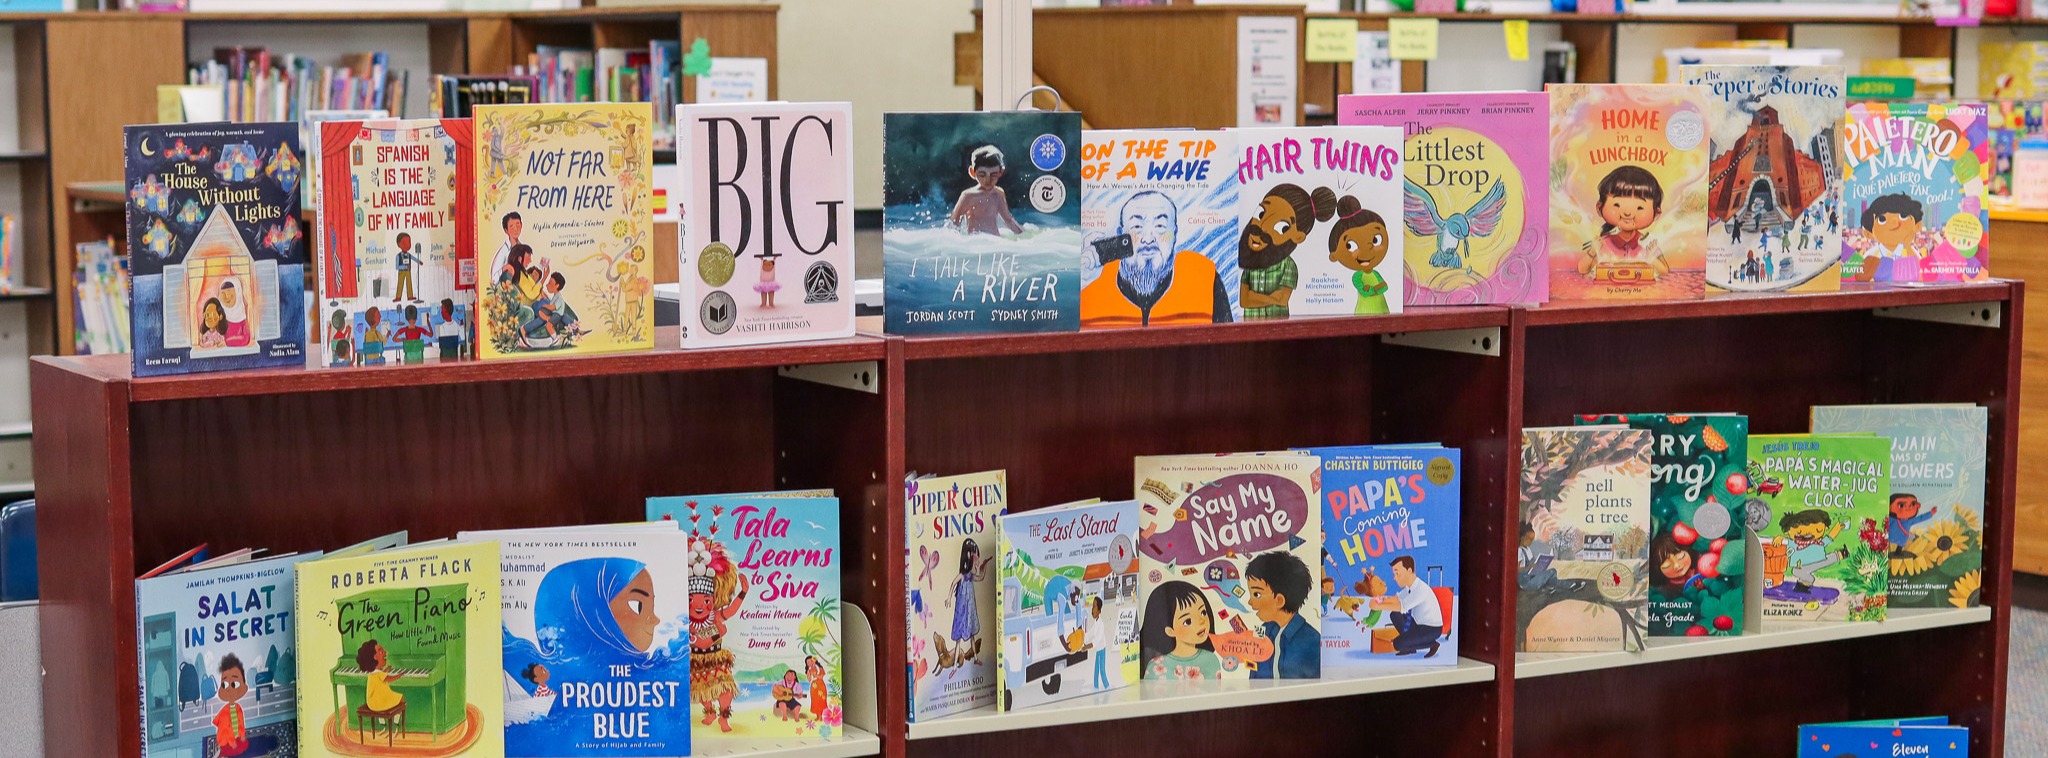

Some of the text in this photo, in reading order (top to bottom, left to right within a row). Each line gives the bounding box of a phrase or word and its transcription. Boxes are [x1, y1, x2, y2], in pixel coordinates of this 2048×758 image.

[1704, 70, 1721, 80] The
[1757, 82, 1768, 91] of
[1769, 74, 1839, 99] Stories
[1384, 108, 1406, 116] ALPER
[1439, 107, 1471, 115] PINKNEY
[1504, 106, 1535, 114] PINKNEY
[1968, 108, 1987, 117] DIAZ
[1404, 121, 1433, 135] The
[1601, 109, 1660, 131] HOME
[1616, 131, 1643, 143] in a
[1844, 115, 1958, 168] PALETERO
[377, 145, 430, 163] SPANISH
[1081, 139, 1217, 161] ON THE TIP
[1404, 137, 1485, 162] Littlest
[1589, 146, 1668, 166] LUNCHBOX
[174, 162, 197, 175] The
[567, 149, 607, 180] FAR
[1238, 136, 1399, 185] HAIR TWINS
[1869, 138, 1941, 181] MAN
[384, 167, 424, 186] IS THE
[1081, 159, 1211, 182] OF A WAVE
[1424, 163, 1490, 193] Drop
[160, 172, 208, 190] House
[698, 115, 844, 259] BIG
[1852, 170, 1921, 199] ¡QUÉ PALETERO
[1909, 183, 1931, 196] TAN
[197, 186, 261, 206] Without
[372, 189, 436, 209] LANGUAGE
[517, 184, 616, 212] FROM HERE
[1926, 189, 1954, 205] COOL!
[234, 202, 281, 224] Lights
[368, 211, 445, 231] OF MY FAMILY
[908, 252, 1021, 282] I TALK LIKE
[951, 273, 1058, 303] A RIVER
[905, 309, 976, 324] JORDAN SCOTT
[991, 309, 1059, 322] SYDNEY SMITH
[735, 320, 812, 333] VASHTI HARRISON
[1324, 459, 1424, 471] CHASTEN BUTTIGIEG
[1914, 452, 1927, 461] OF
[1240, 463, 1298, 471] JOANNA HO
[1820, 459, 1884, 477] MAGICAL
[1585, 478, 1613, 493] nell
[1788, 474, 1878, 493] WATER-JUG
[912, 483, 1002, 516] PIPER CHEN
[1190, 481, 1276, 522] Say My
[1327, 473, 1426, 521] PAPA'S
[1585, 495, 1632, 511] plants
[1804, 492, 1855, 508] CLOCK
[730, 505, 791, 541] Tala
[933, 510, 984, 540] SINGS
[1028, 511, 1120, 543] THE Last Stand
[1343, 507, 1411, 536] Coming
[1585, 512, 1629, 524] a tree
[1191, 510, 1292, 556] Name
[1339, 518, 1428, 566] HOME
[737, 538, 833, 570] Learns
[331, 558, 472, 589] ROBERTA FLACK
[186, 578, 215, 589] JAMILAH
[750, 570, 820, 602] to Siva
[197, 584, 276, 619] SALAT
[359, 598, 381, 614] The
[338, 587, 473, 639] Green Piano
[740, 609, 772, 620] Kealani
[1663, 612, 1695, 628] Goade
[184, 611, 289, 649] IN SECRET
[390, 625, 436, 640] How Little Me
[417, 636, 439, 648] Found
[748, 638, 787, 650] Dung Ho
[1221, 644, 1265, 656] KHOA LE
[1325, 640, 1351, 648] TAYLOR
[608, 664, 632, 678] THE
[972, 676, 984, 686] SOO
[561, 681, 680, 709] PROUDEST
[593, 712, 650, 739] BLUE
[1892, 742, 1929, 757] Eleven
